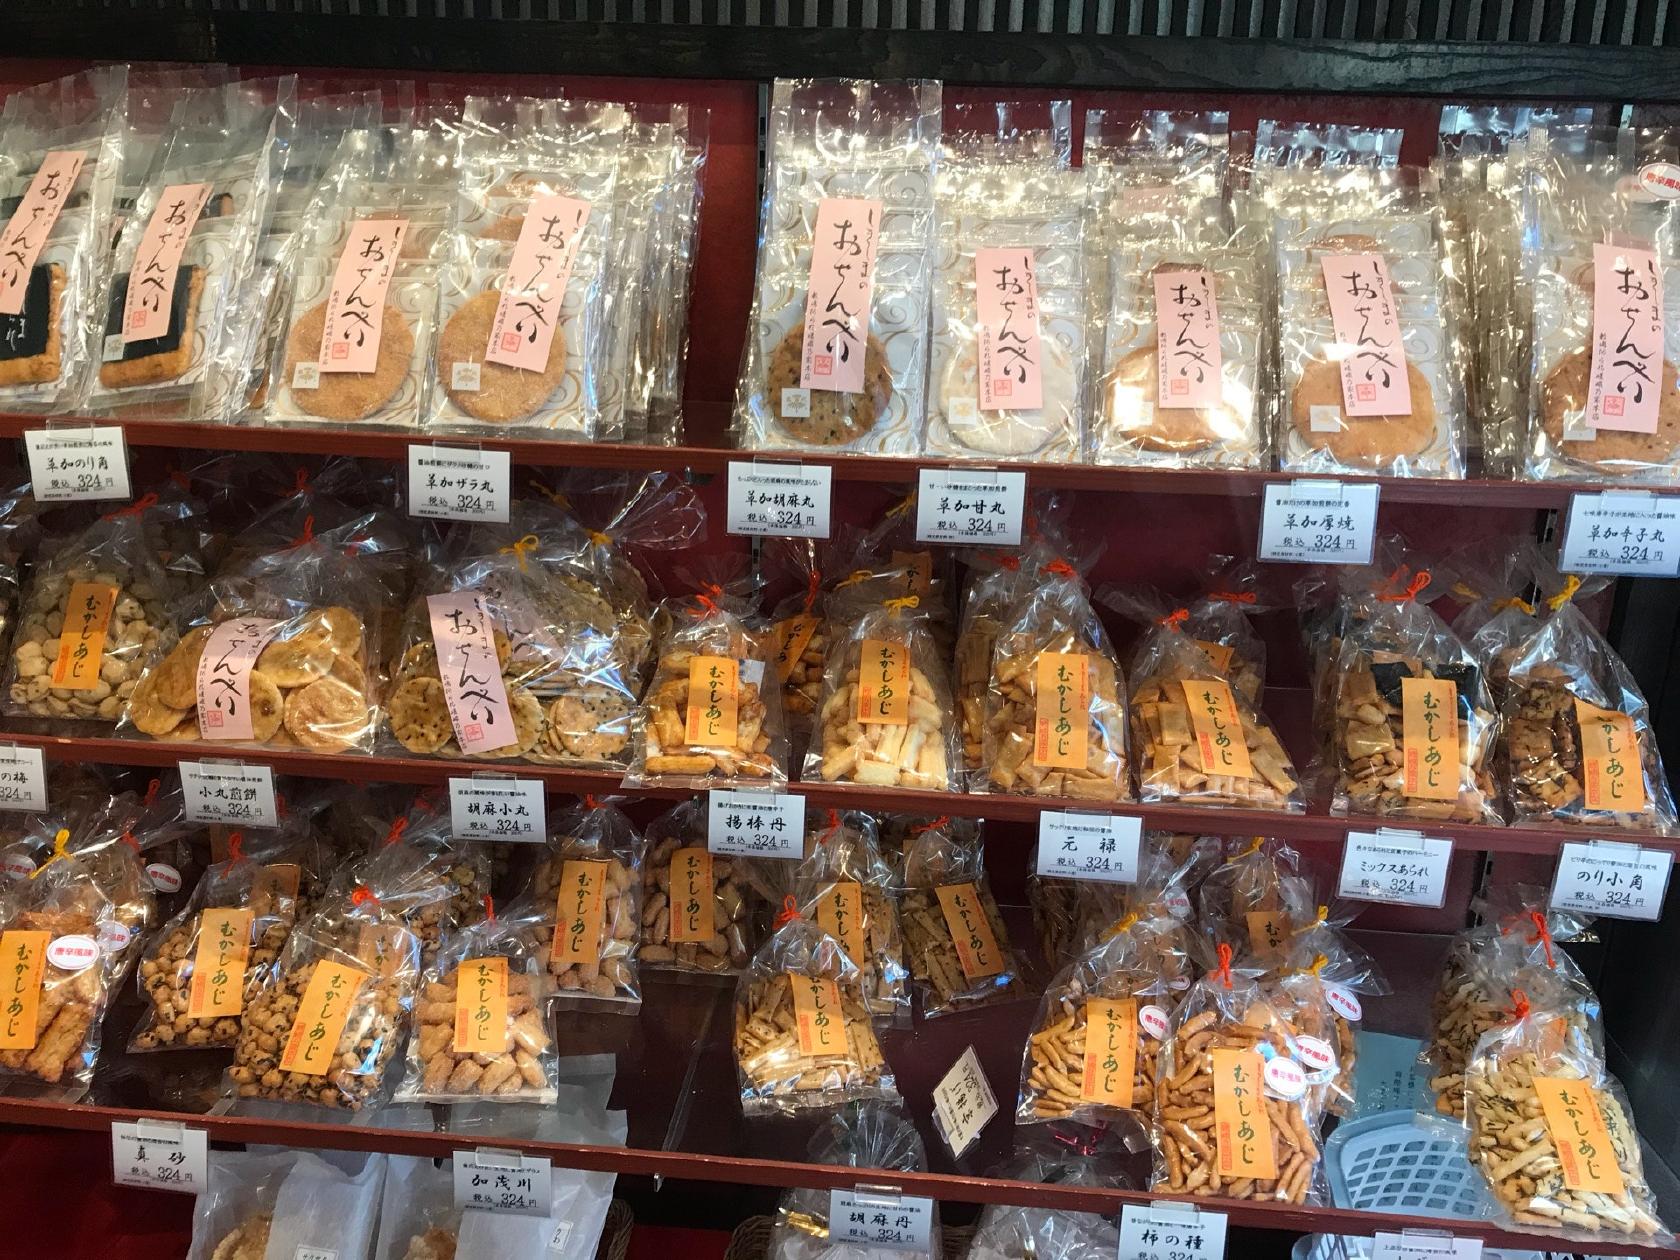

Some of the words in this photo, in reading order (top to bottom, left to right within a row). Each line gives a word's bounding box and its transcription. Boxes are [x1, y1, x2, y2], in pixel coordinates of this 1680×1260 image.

[1, 171, 61, 287] おせんべい
[141, 200, 186, 313] おせんべい
[341, 235, 384, 347] おせんべい
[515, 215, 565, 343] おせんべい
[823, 219, 861, 363] おせんべい
[992, 266, 1034, 384] おせんべい
[1170, 284, 1214, 384] おせんべい
[1341, 271, 1398, 388] おせんべい
[1612, 266, 1656, 404] おせんべい
[46, 456, 109, 471] 草加のり角
[51, 479, 71, 489] 税込
[425, 473, 494, 493] 草加ザラ丸
[429, 497, 448, 506] 税込
[743, 490, 815, 508] 草加胡麻丸
[747, 513, 766, 522] 税込
[937, 497, 1006, 515] 草加甘丸
[937, 520, 958, 530] 税込
[1283, 514, 1355, 531] 草加厚焼
[1282, 538, 1305, 548] 税込
[1587, 525, 1665, 543] 草加辛子丸
[1588, 549, 1610, 559] 税込
[71, 595, 100, 678] むかしあじ
[444, 609, 499, 724] おせんべい
[705, 666, 726, 735] むかしあじ
[877, 648, 896, 716] むかしあじ
[1055, 664, 1074, 757] むかしあじ
[1203, 690, 1233, 766] むかしあじ
[1423, 691, 1442, 787] むかしあじ
[1598, 717, 1625, 799] かしあじ
[200, 788, 258, 801] 小丸煎餅
[468, 802, 529, 817] 胡麻小丸
[470, 822, 489, 831] 税込
[726, 815, 786, 832] 揚棒丹
[727, 836, 746, 845] 税込
[1056, 857, 1076, 866] 税込
[1360, 861, 1430, 877] ミックスあられ
[570, 872, 593, 953] むかしあじ
[686, 855, 701, 931] むかしあじ
[1575, 891, 1595, 901] 税込
[1577, 870, 1644, 890] のり小角
[211, 920, 237, 1006] むかしあじ
[954, 894, 988, 967] むかしあじ
[7, 943, 33, 1038] むかしあじ
[304, 973, 348, 1062] むかしあじ
[474, 964, 494, 1041] むかしあじ
[1102, 1008, 1122, 1093] むかしあじ
[1233, 1063, 1255, 1165] むかしあじ
[1558, 1090, 1600, 1180] むかしあじ
[472, 1174, 532, 1193] 加茂川
[473, 1194, 492, 1203] 税込
[850, 1213, 912, 1229] 胡麻丹
[850, 1228, 868, 1237] 税込
[1142, 1229, 1204, 1250] 柿の種
